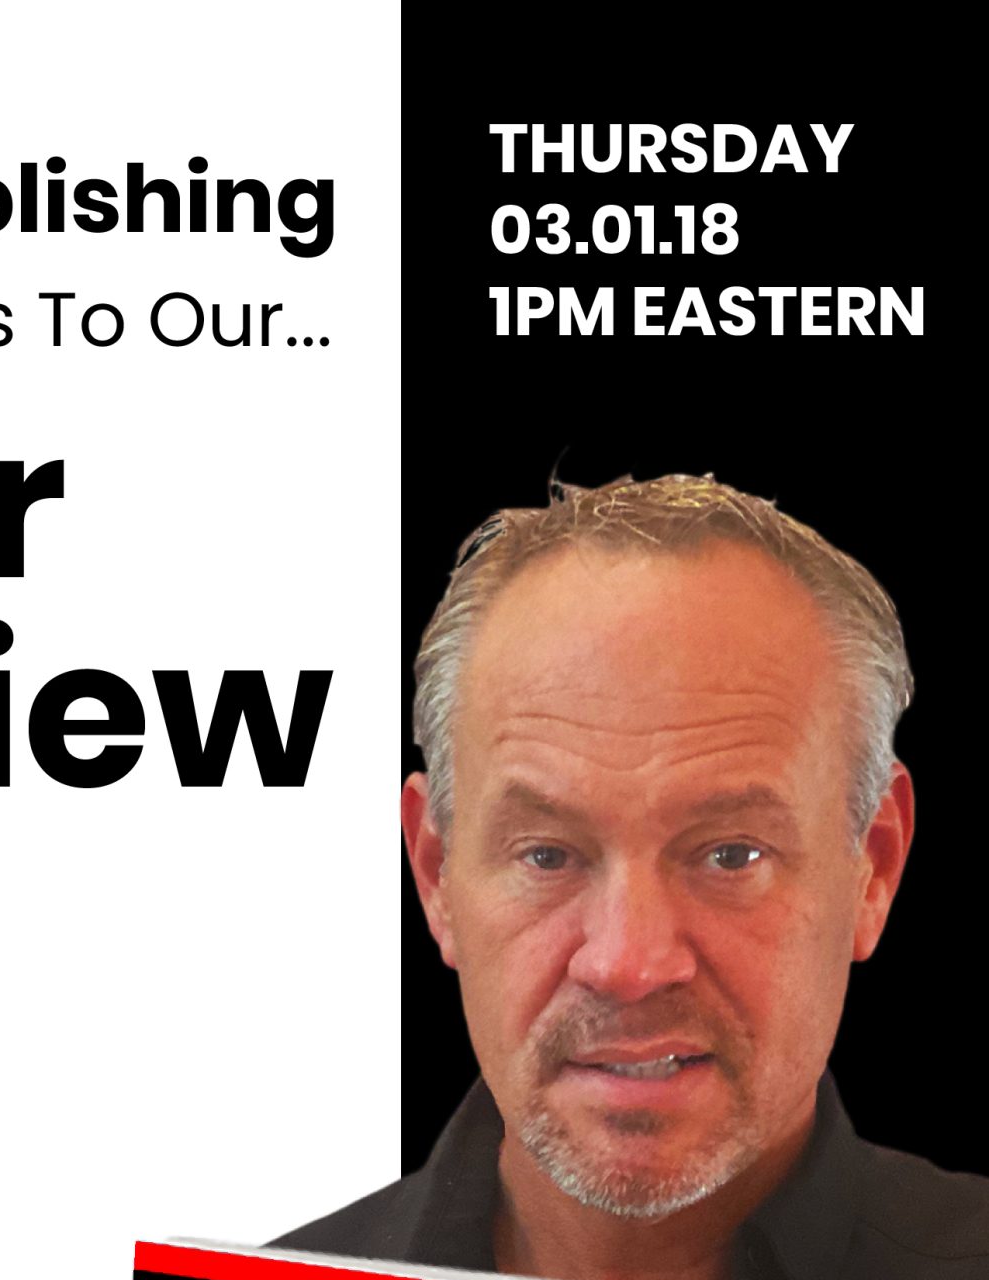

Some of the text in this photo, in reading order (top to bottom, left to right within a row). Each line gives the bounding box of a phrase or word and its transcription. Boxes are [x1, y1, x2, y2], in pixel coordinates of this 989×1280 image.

[490, 124, 854, 173] THURSDAY
[492, 203, 738, 255] 03.01.18
[39, 293, 124, 347] To
[151, 292, 329, 347] Our...
[489, 286, 923, 336] 1PM EASTERN
